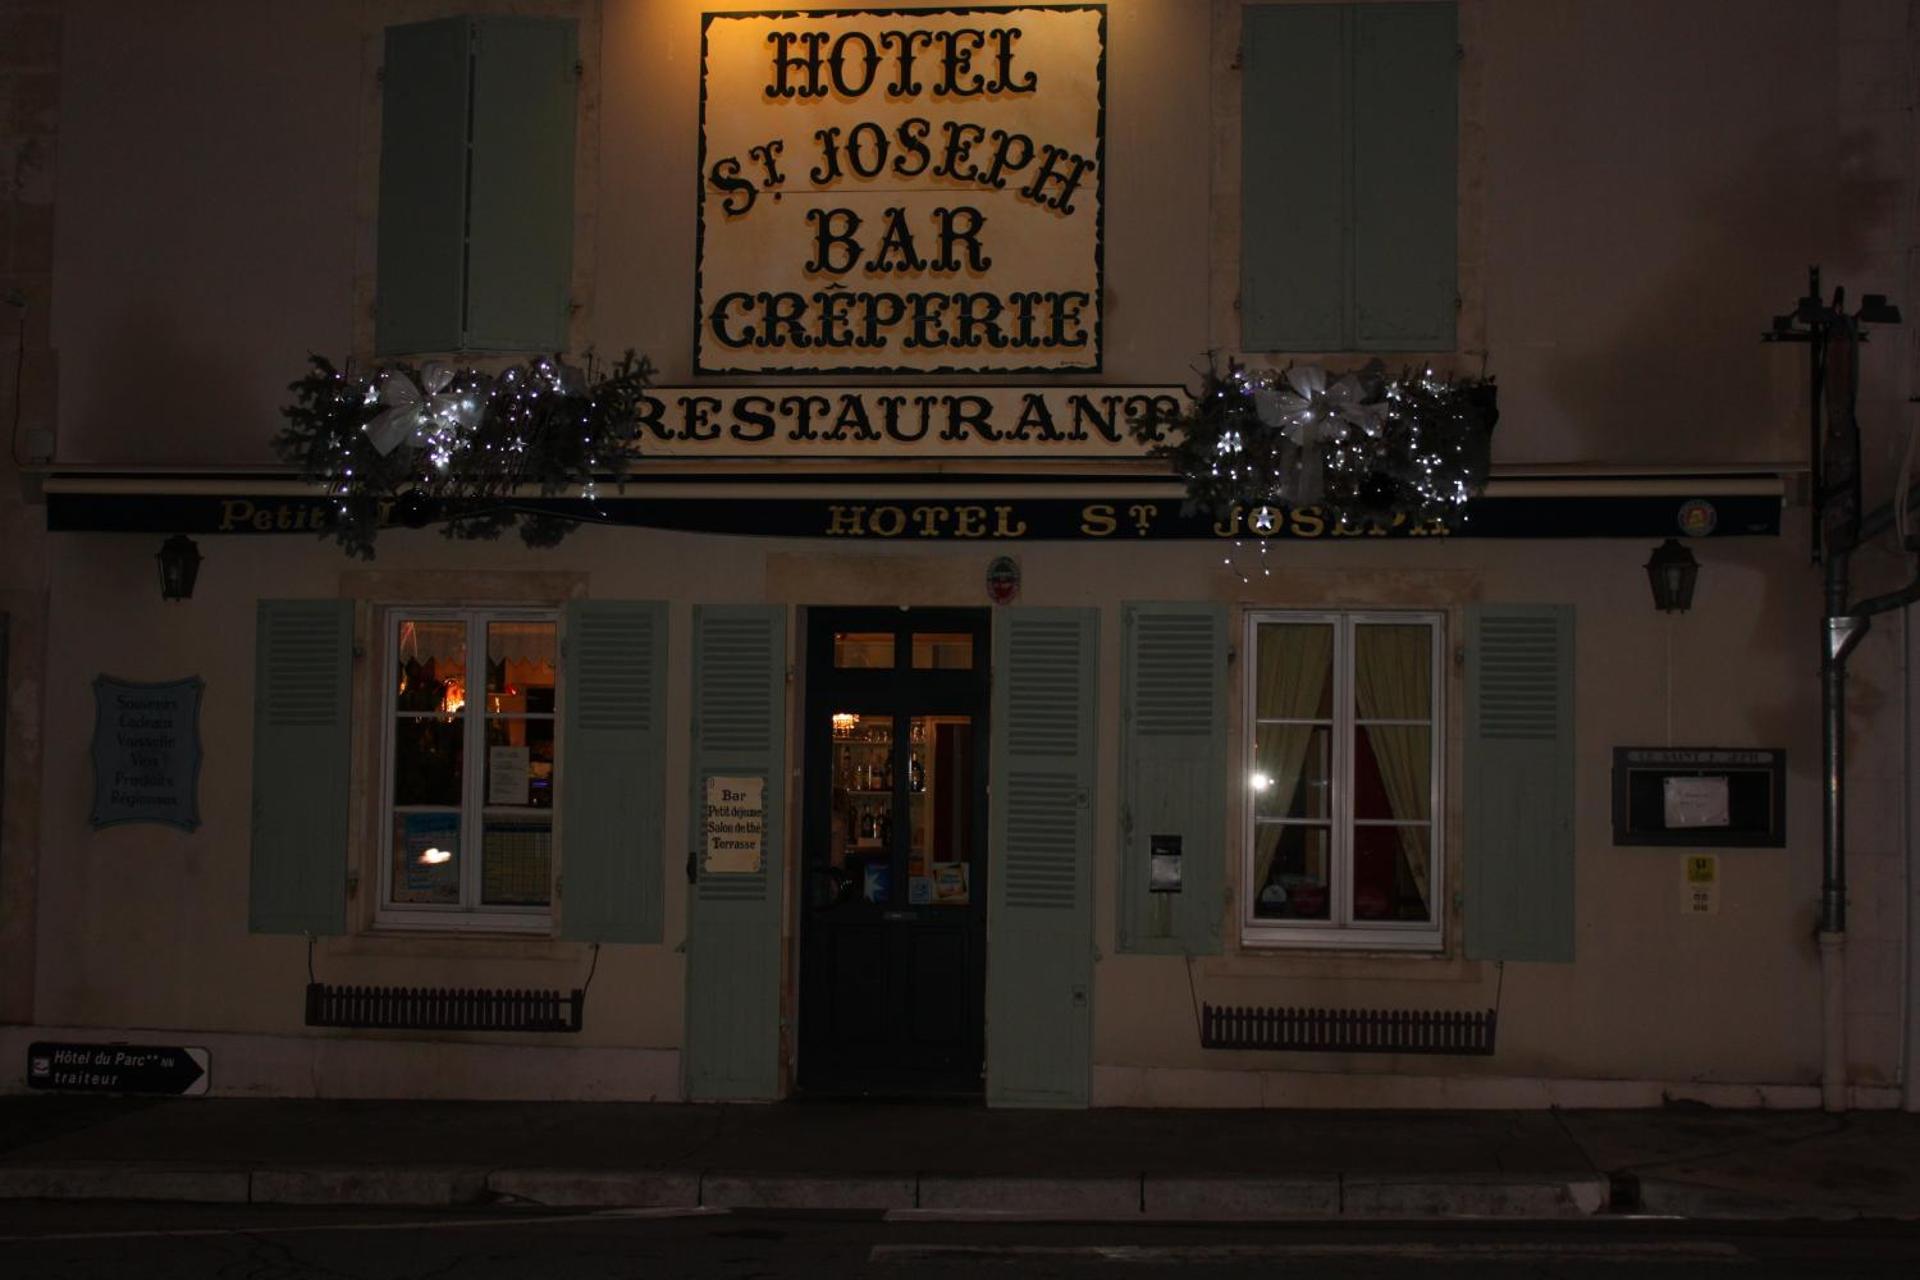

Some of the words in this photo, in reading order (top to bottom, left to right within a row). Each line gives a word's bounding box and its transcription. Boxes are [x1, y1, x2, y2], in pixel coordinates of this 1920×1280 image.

[765, 28, 1036, 98] HOTEL
[810, 118, 1095, 216] JOSEPH
[805, 207, 991, 274] BAR
[709, 283, 1089, 348] CRÊPERIE
[633, 393, 1180, 442] RESTAURANT
[218, 499, 325, 531] Petit
[825, 504, 1027, 537] HOTEL
[708, 805, 731, 817] Petit
[721, 789, 746, 801] Bar
[707, 821, 734, 833] Salon
[735, 821, 746, 833] de
[712, 837, 756, 849] Terrasse
[54, 1050, 91, 1064] Hôtel
[95, 1052, 111, 1065] du
[54, 1070, 119, 1086] traiteur
